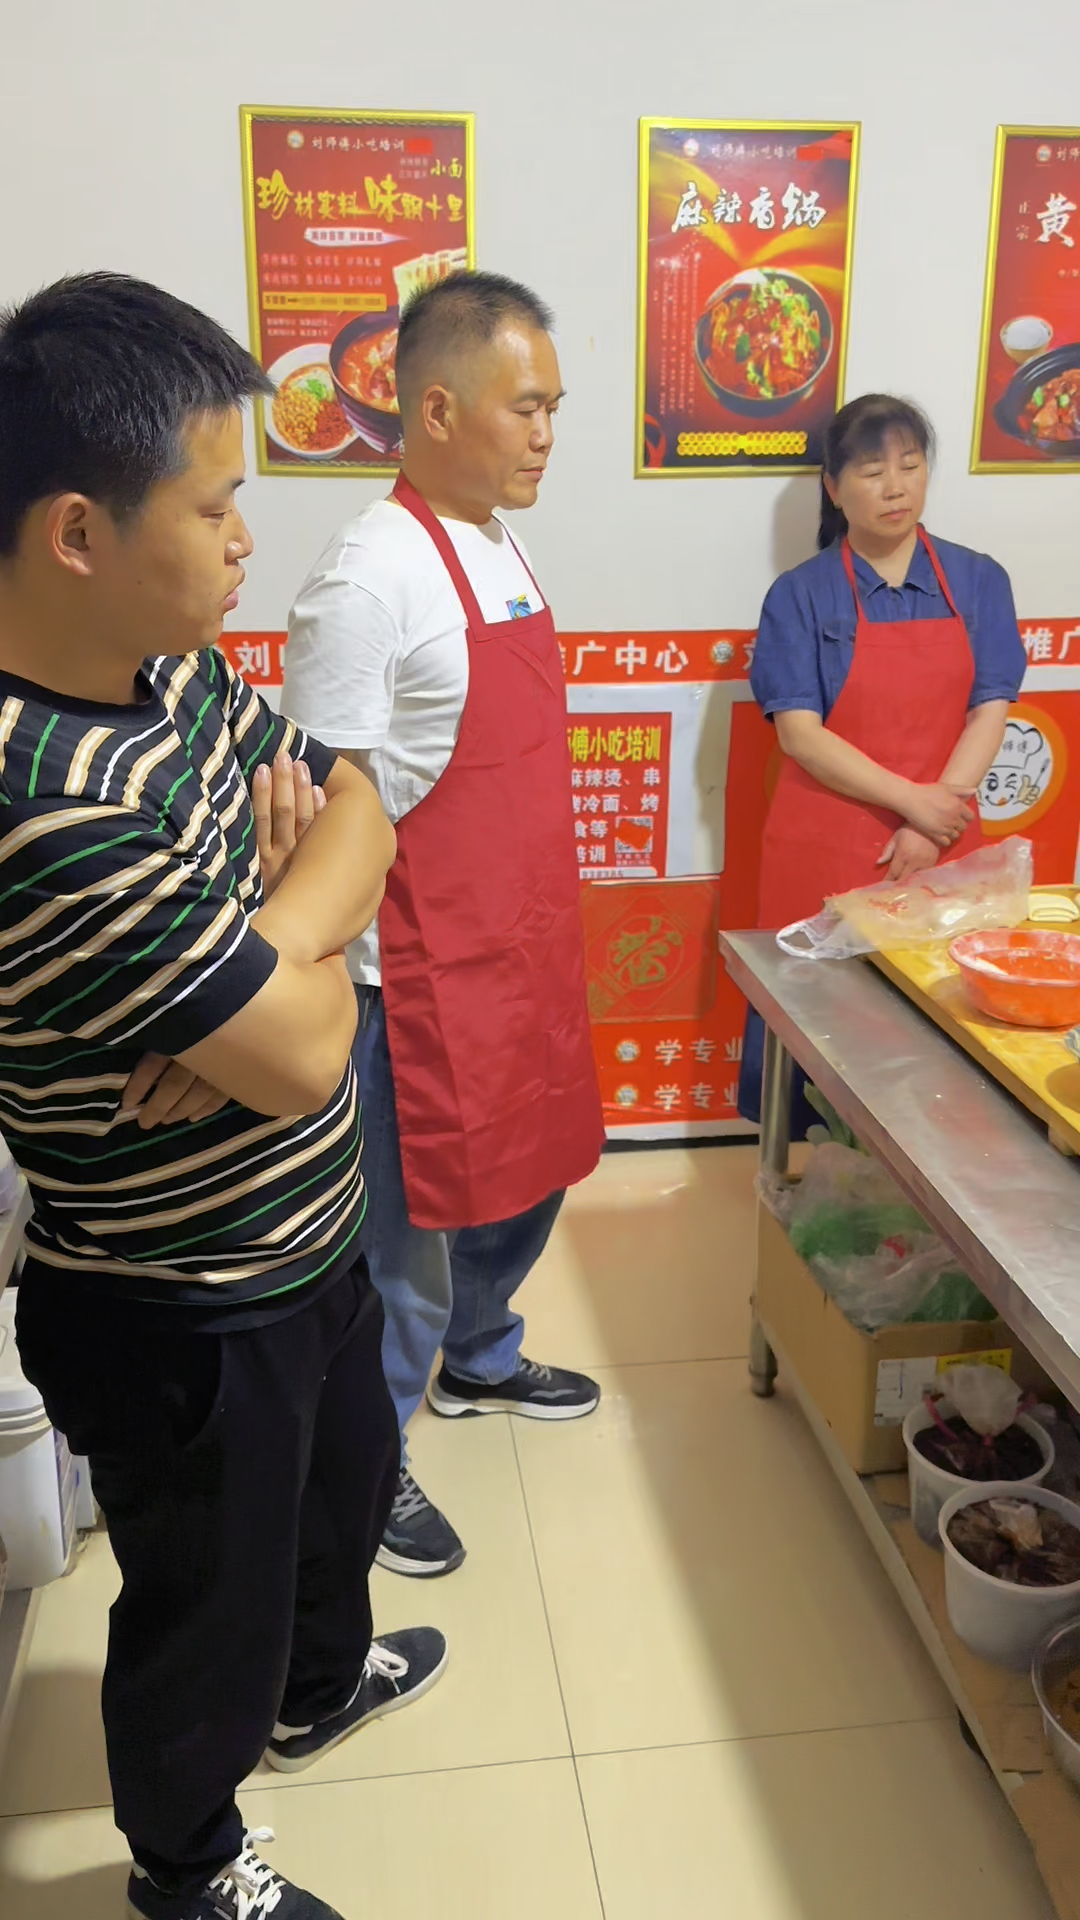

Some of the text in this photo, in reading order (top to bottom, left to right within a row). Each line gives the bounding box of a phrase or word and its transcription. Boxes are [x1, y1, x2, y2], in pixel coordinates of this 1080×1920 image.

[671, 180, 827, 233] 麻辣香锅
[1034, 192, 1078, 248] 黄
[234, 640, 285, 677] 刘
